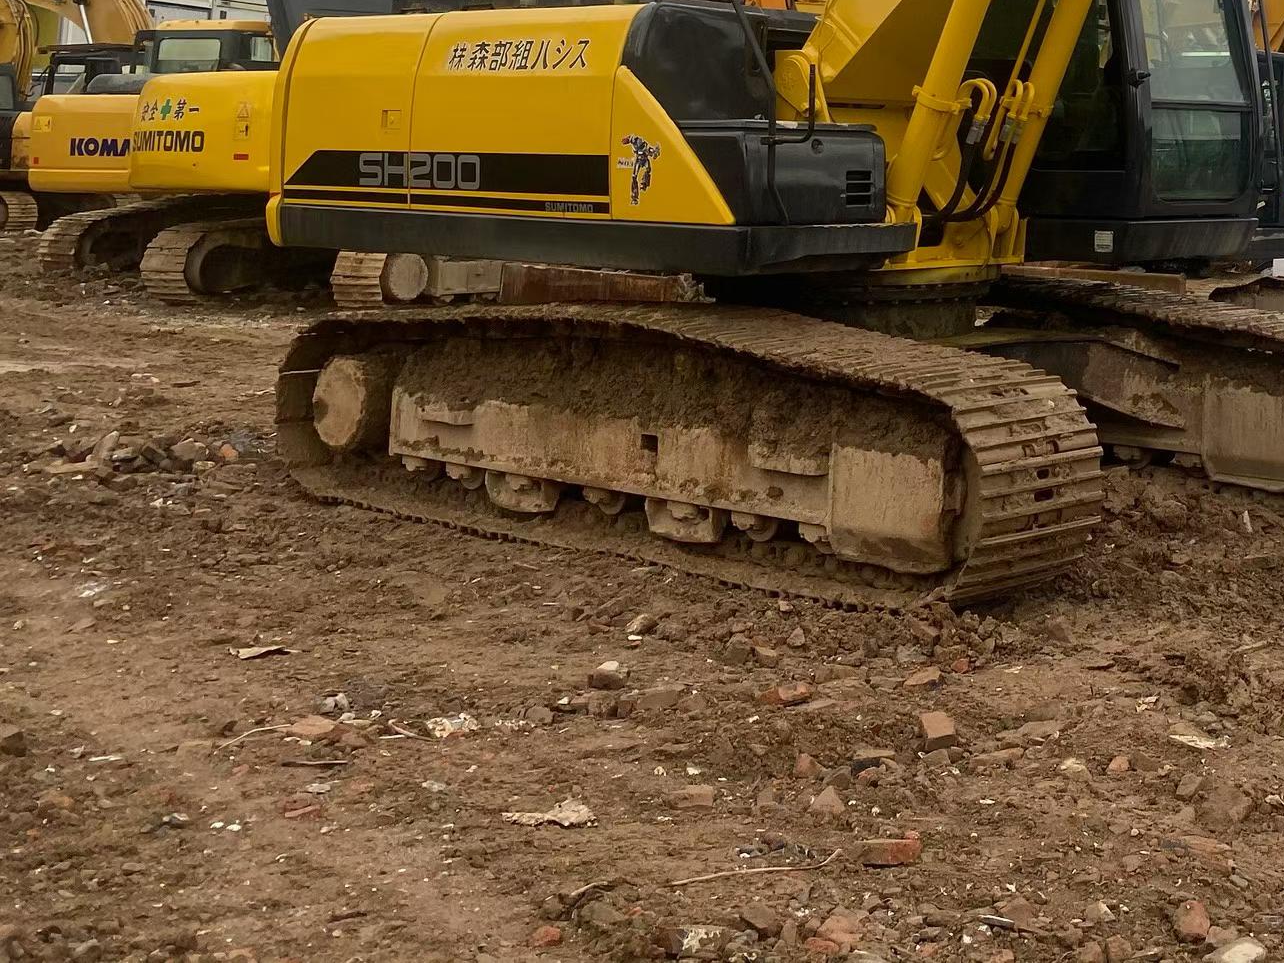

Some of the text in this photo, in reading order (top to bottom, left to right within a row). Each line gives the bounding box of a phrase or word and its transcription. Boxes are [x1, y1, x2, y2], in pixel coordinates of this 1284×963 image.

[70, 138, 130, 156] KOMA
[132, 130, 205, 153] SUMITOMO
[359, 152, 481, 191] SH200
[544, 201, 594, 213] SUMITOMO
